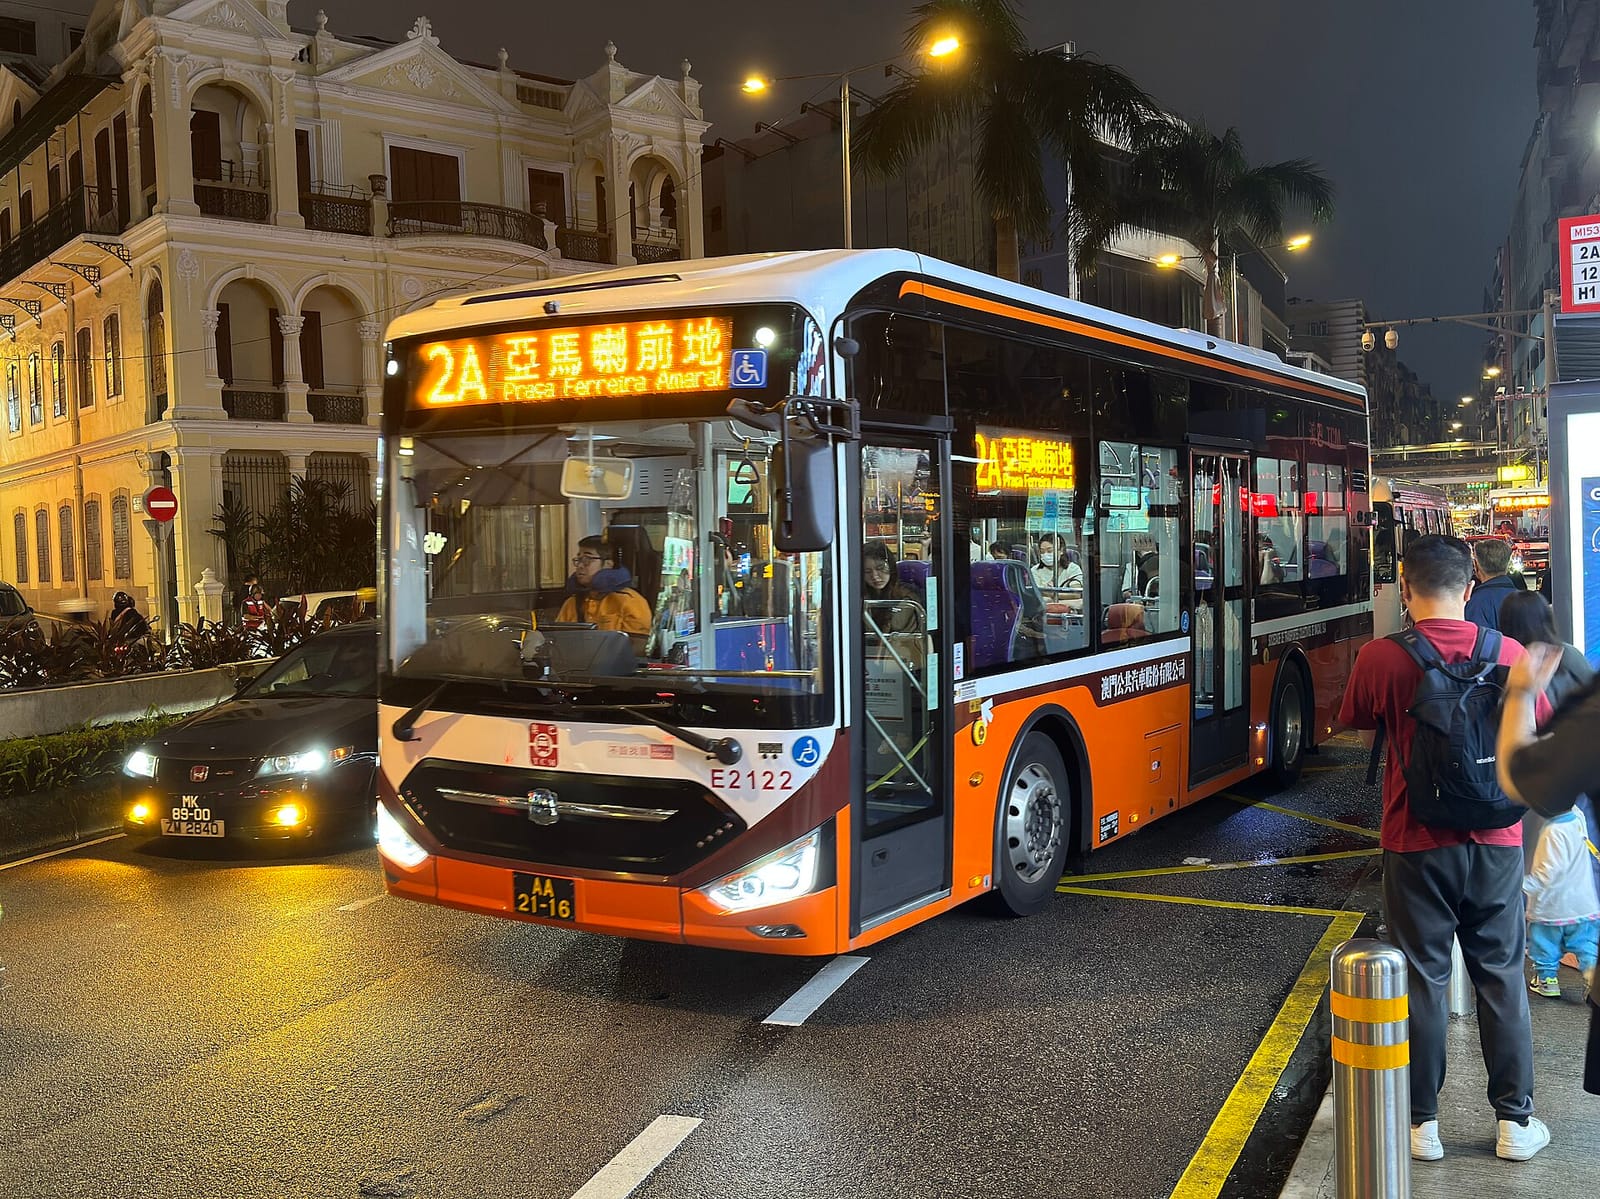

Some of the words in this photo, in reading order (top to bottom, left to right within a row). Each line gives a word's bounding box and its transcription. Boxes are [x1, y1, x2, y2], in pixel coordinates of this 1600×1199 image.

[1580, 245, 1600, 260] 2A
[1581, 266, 1598, 281] 12
[1578, 285, 1596, 301] H1
[504, 317, 724, 380] 亞馬喇前地
[426, 343, 488, 404] 2A
[564, 375, 647, 397] Ferreira
[655, 366, 724, 391] Amaral
[975, 433, 1002, 486] 2A
[712, 769, 792, 790] E2122
[182, 795, 199, 808] MK
[172, 807, 211, 821] 89-00
[186, 822, 219, 835] 2840
[532, 877, 555, 898] AA
[517, 894, 571, 919] 21-16
